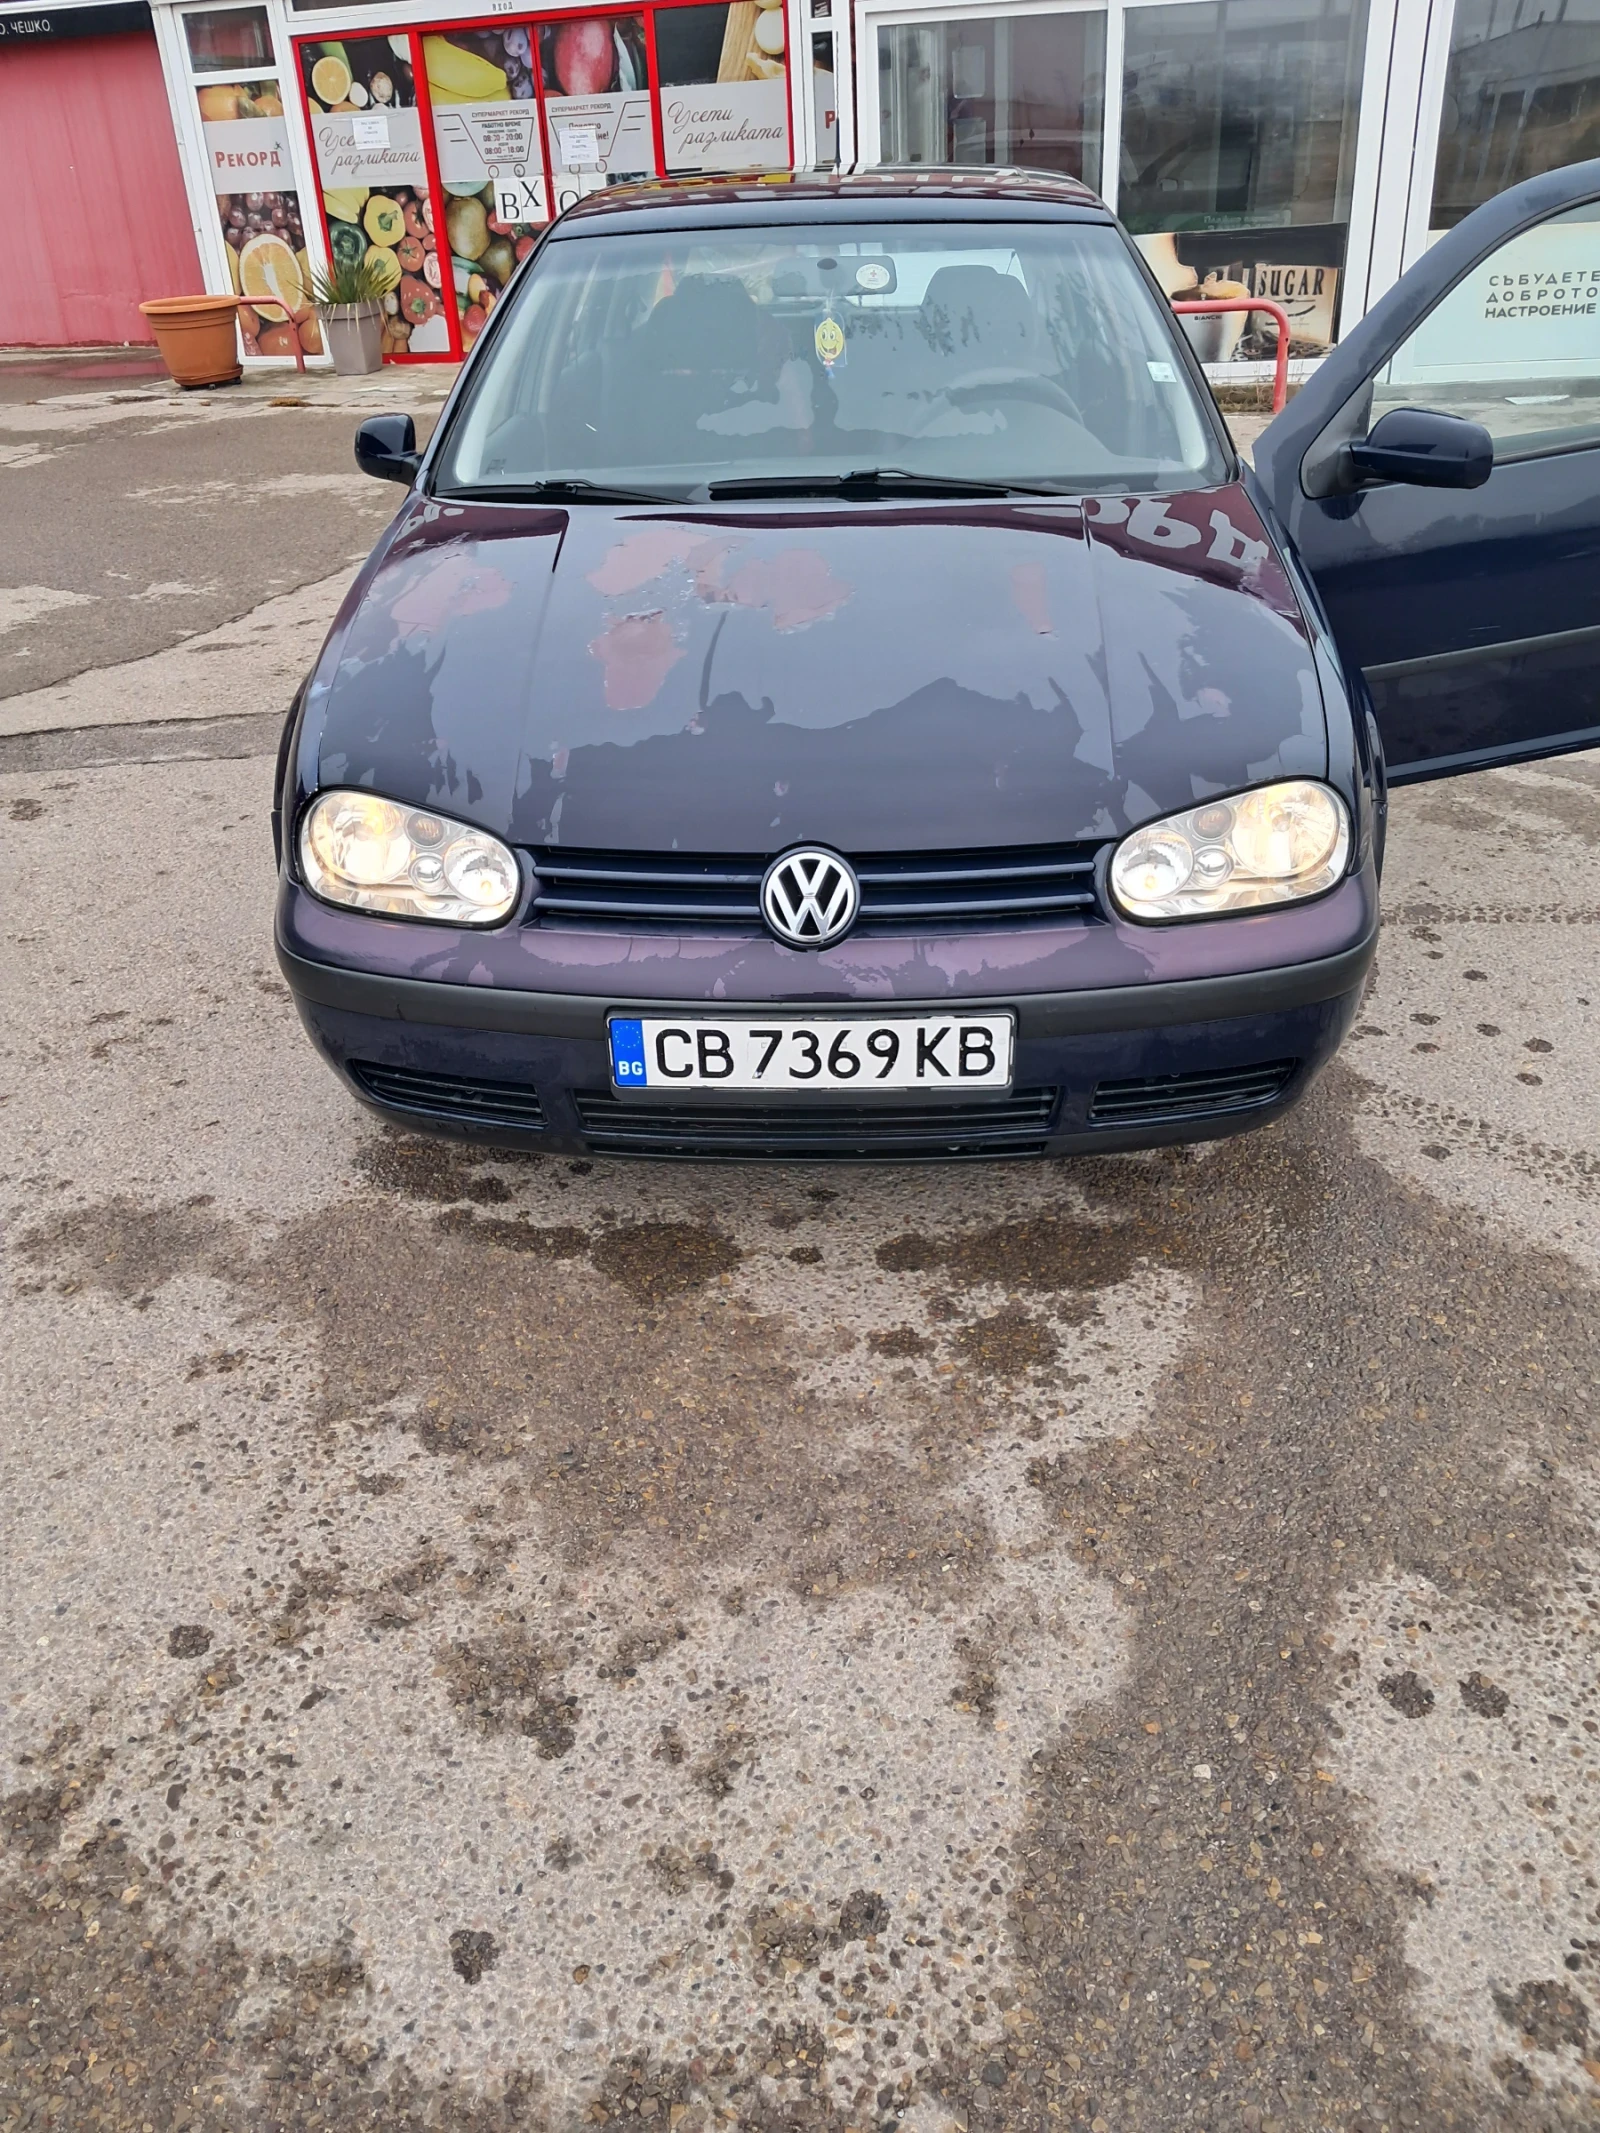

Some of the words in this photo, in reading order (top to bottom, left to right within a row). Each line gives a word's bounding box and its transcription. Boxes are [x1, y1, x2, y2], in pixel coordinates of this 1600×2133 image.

[551, 104, 589, 112] СУПЕРМАРКЕТ
[667, 101, 733, 134] Усети
[678, 118, 784, 154] разликата
[1258, 269, 1325, 296] SUGAR
[1489, 270, 1600, 286] СЪБУДЕТЕ
[1486, 287, 1598, 303] ДОБРОТО
[1485, 303, 1597, 318] НАСТРОЕНИЕ
[748, 1029, 900, 1079] 7369
[618, 1061, 643, 1076] BG
